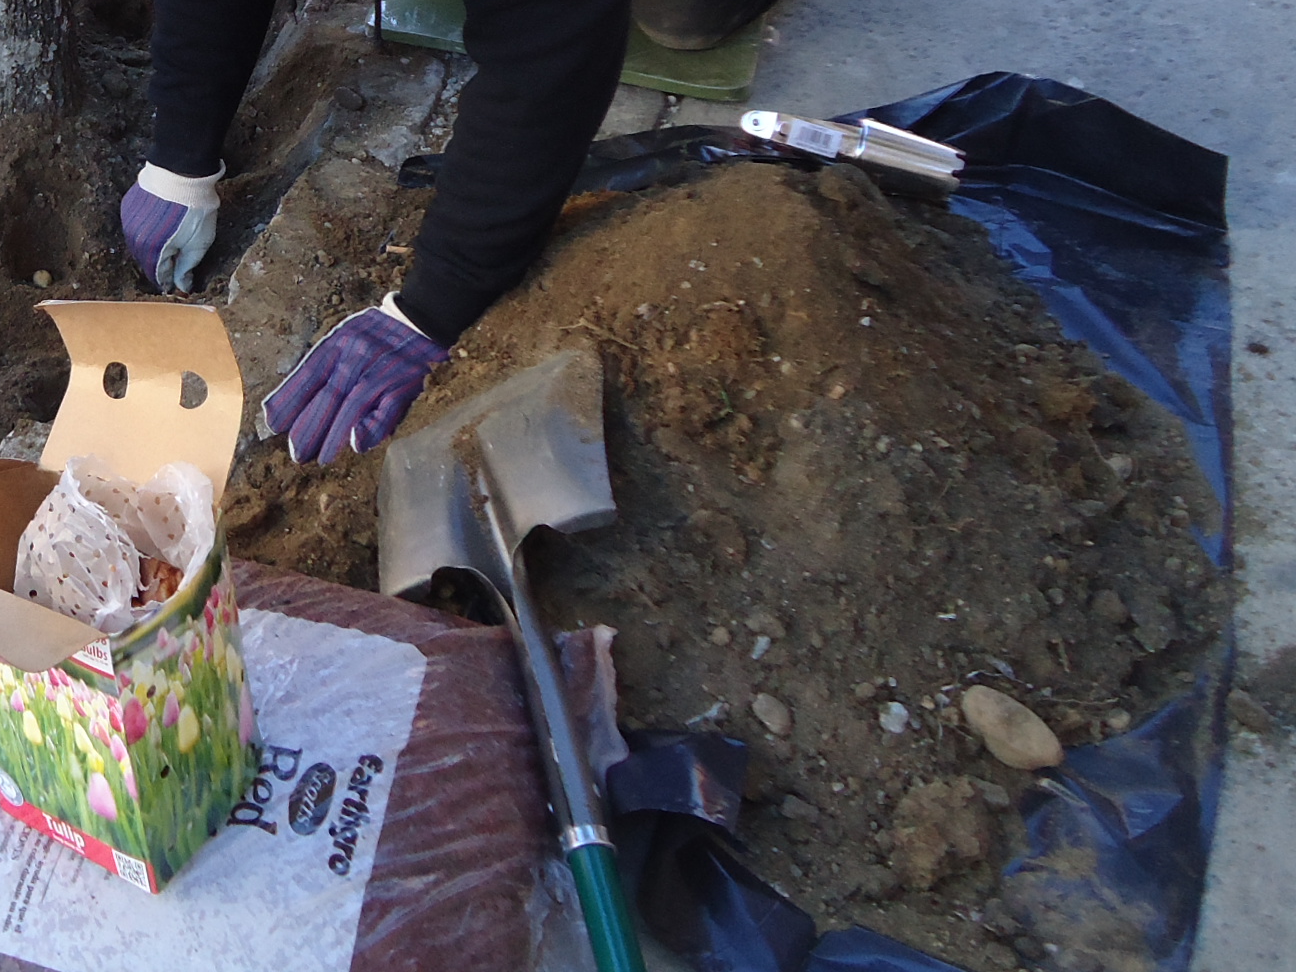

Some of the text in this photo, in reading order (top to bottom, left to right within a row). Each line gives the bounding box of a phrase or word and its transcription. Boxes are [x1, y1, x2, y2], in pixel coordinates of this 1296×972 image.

[296, 770, 331, 826] Scotts
[328, 754, 384, 876] Earthgro
[42, 811, 86, 851] Tulip
